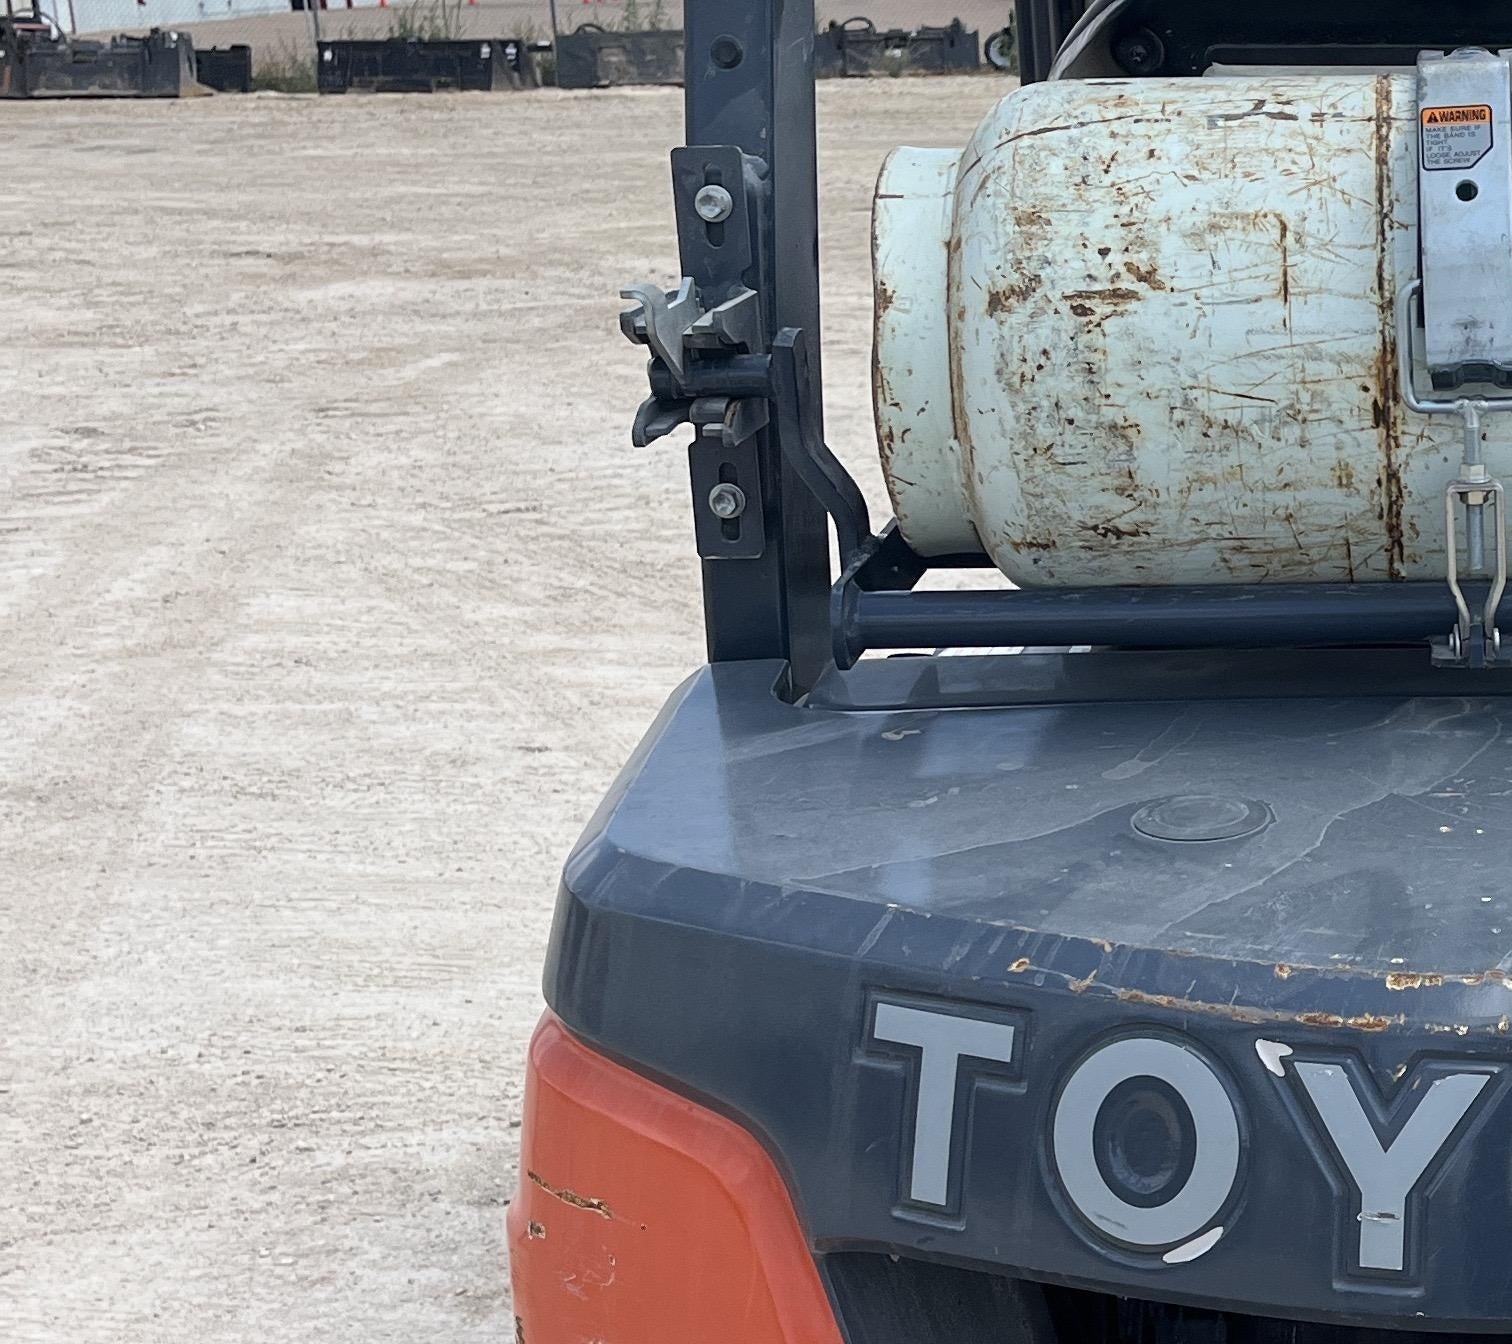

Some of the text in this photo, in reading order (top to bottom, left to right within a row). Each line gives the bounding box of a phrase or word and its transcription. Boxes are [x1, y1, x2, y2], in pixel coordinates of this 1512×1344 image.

[1439, 109, 1487, 122] WARNING
[1444, 131, 1466, 139] BAND
[1454, 150, 1481, 158] ADJUST
